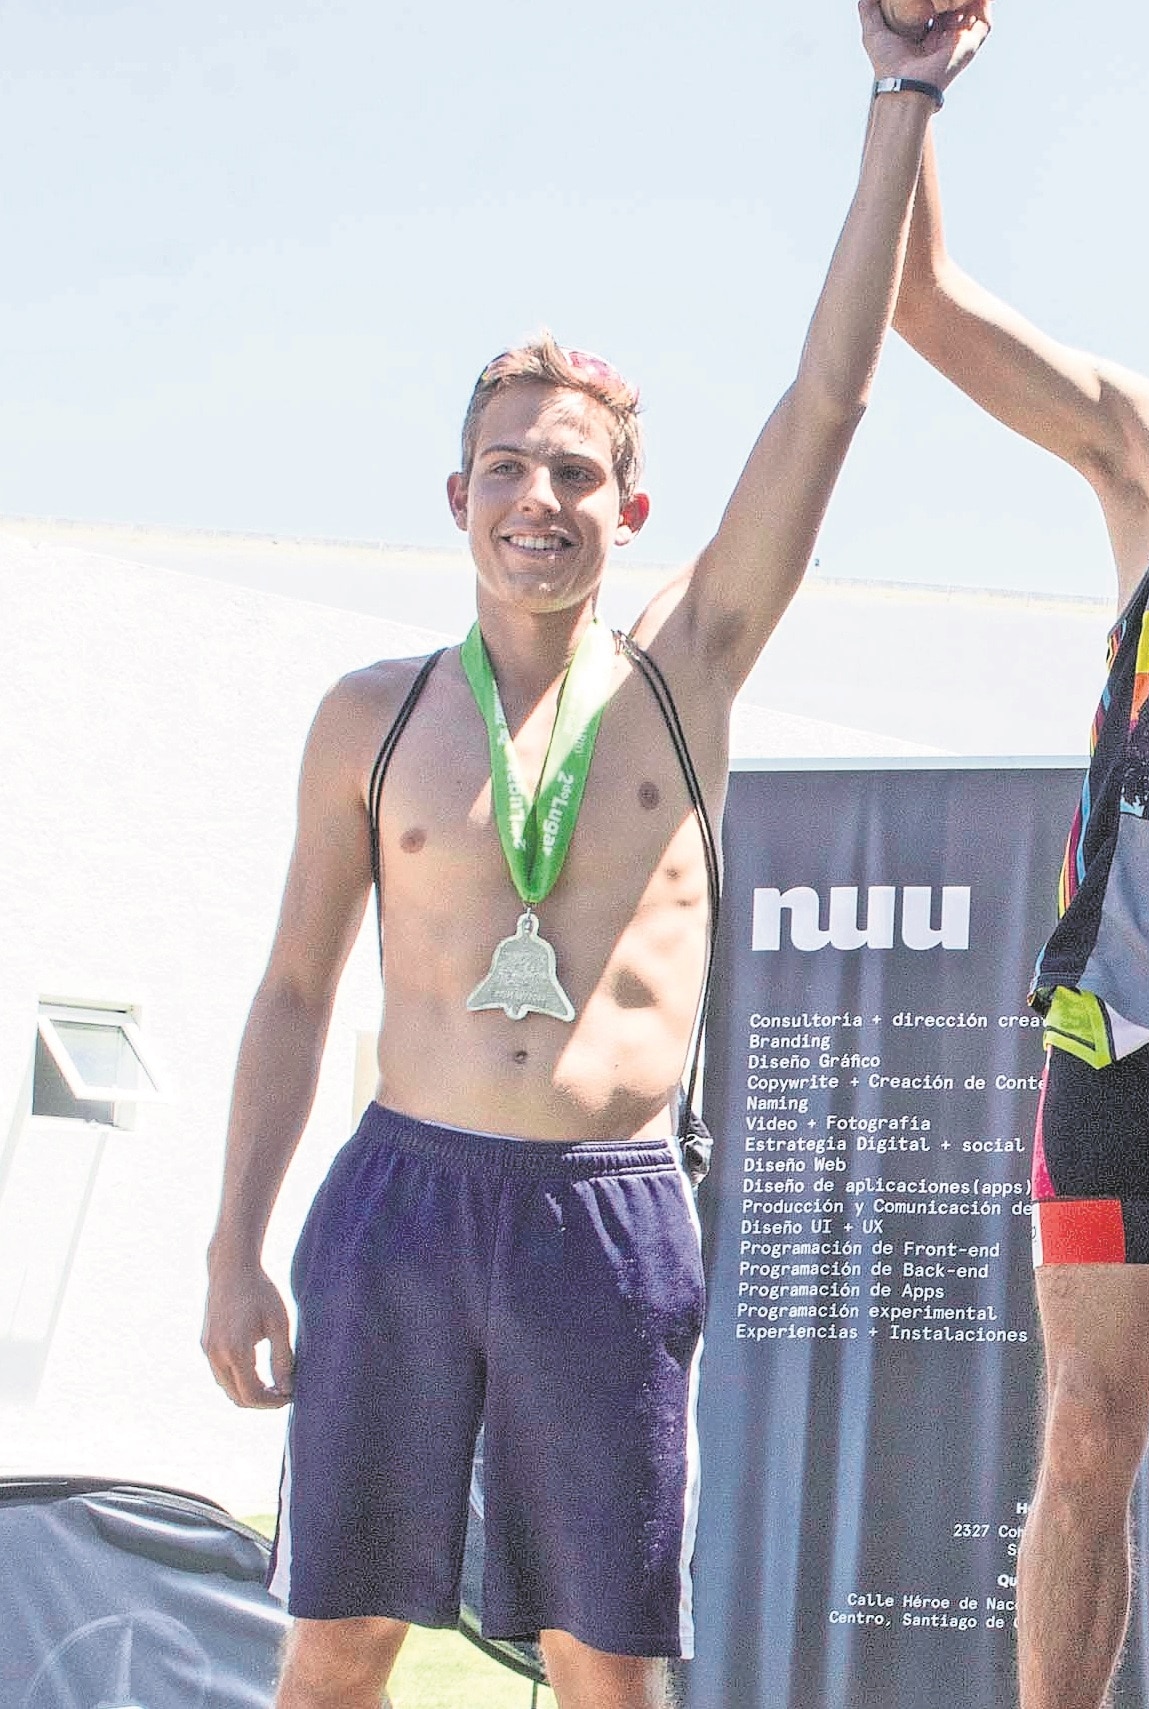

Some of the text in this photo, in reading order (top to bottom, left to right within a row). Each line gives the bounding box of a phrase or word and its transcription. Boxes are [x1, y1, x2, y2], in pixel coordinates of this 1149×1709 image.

[542, 796, 569, 857] Lugar
[752, 886, 971, 951] nuu
[750, 1013, 862, 1028] Consultoría
[872, 1016, 882, 1025] +
[893, 1013, 987, 1028] dirección
[750, 1034, 830, 1050] Branding
[748, 1054, 880, 1069] Diseño Gráfico
[748, 1075, 838, 1092] Copywrite
[850, 1078, 859, 1087] +
[869, 1074, 953, 1089] Creación
[964, 1075, 985, 1089] de
[747, 1096, 808, 1113] Naming
[747, 1116, 931, 1133] Video + Fotografía
[746, 1137, 1025, 1153] Estrategia Digital + social
[744, 1158, 846, 1172] Diseño Web
[743, 1179, 1032, 1196] Diseño de aplicaciones(apps)
[742, 1199, 1032, 1216] Producción y Comunicación de
[741, 1220, 883, 1234] Diseño UI + UX
[741, 1241, 999, 1258] Programación de Front-end
[739, 1262, 988, 1279] Programación de Back-end
[739, 1282, 944, 1301] Programación de Apps
[738, 1304, 997, 1322] Programación experimental
[736, 1324, 1027, 1342] Experiencias + Instalaciones
[954, 1525, 989, 1537] 2327
[848, 1594, 894, 1607] Calle
[903, 1593, 950, 1609] Héroe
[959, 1596, 977, 1609] de
[829, 1611, 891, 1627] Centro,
[903, 1613, 976, 1630] Santiago
[986, 1616, 1003, 1628] de
